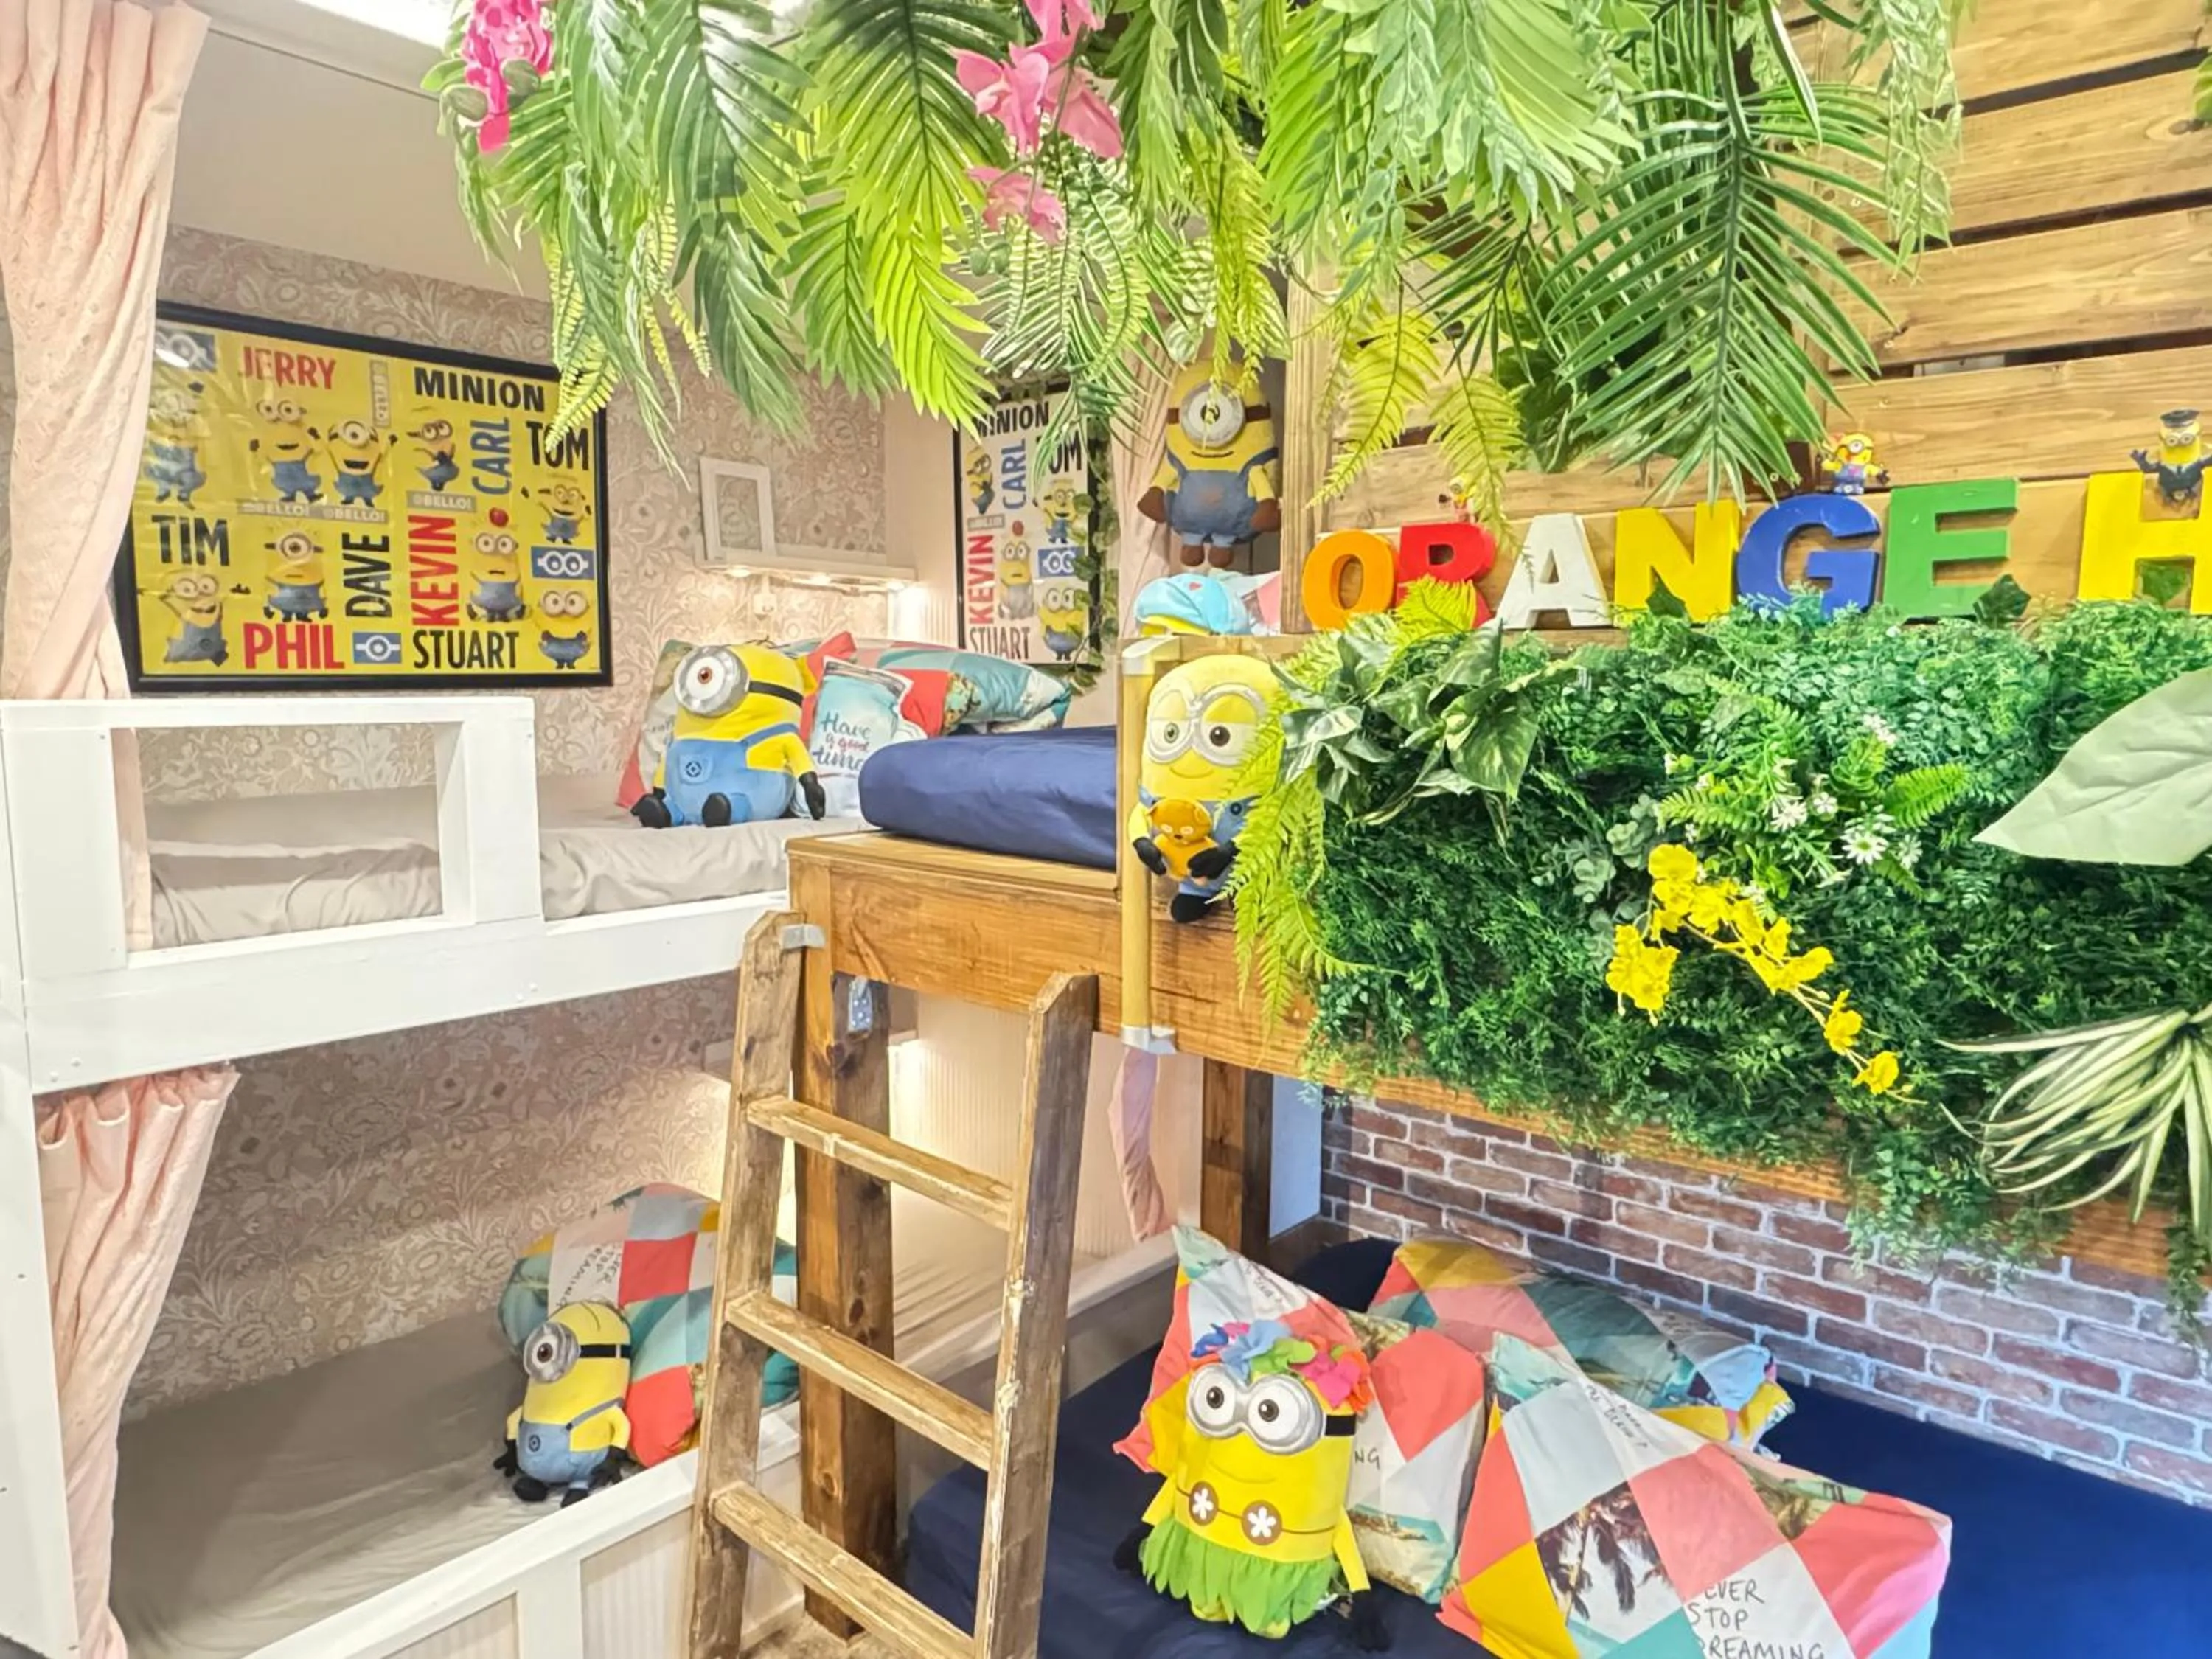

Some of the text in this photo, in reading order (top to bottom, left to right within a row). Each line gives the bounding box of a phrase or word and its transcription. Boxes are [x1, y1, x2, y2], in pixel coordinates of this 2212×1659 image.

[237, 346, 336, 389] JERRY
[414, 367, 546, 412] MINION
[470, 417, 512, 495] CARL
[526, 421, 589, 471] TOM
[1001, 438, 1027, 509] CARL
[152, 515, 231, 566] TIM
[1302, 477, 2019, 631] ORANGE
[341, 532, 393, 618] DAVE
[408, 514, 460, 626] KEVIN
[967, 535, 994, 624] KEVIN
[243, 623, 345, 669] PHIL
[413, 630, 520, 669] STUART
[970, 627, 1030, 660] STUART
[821, 711, 871, 740] Have
[1687, 1602, 1749, 1630] STOP
